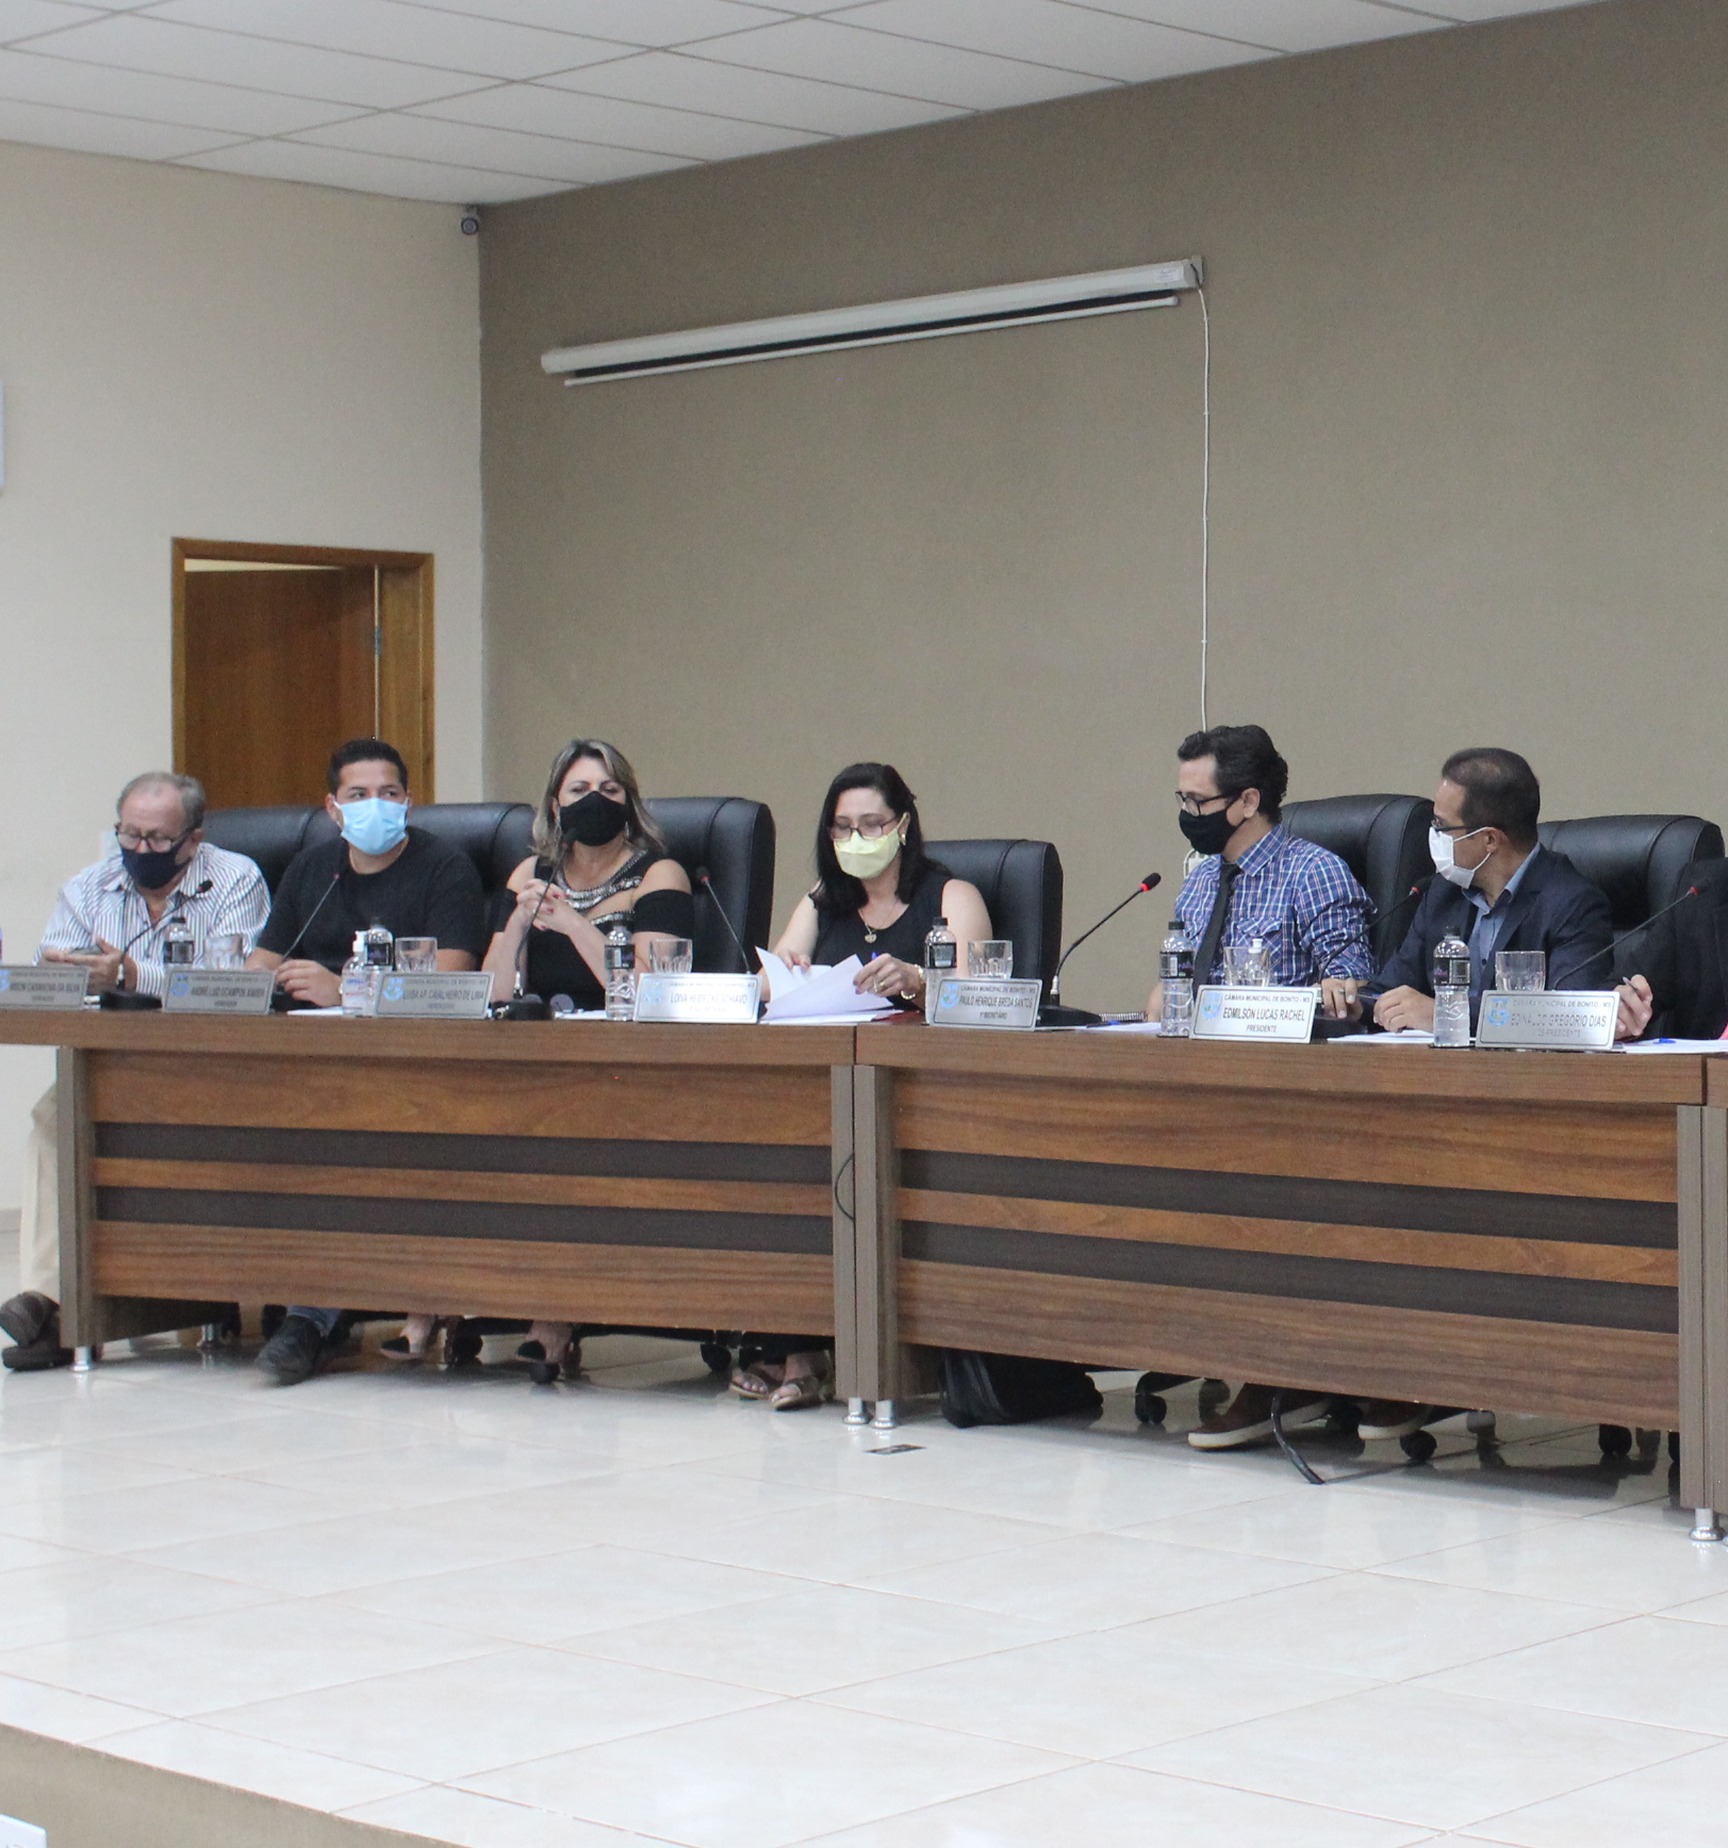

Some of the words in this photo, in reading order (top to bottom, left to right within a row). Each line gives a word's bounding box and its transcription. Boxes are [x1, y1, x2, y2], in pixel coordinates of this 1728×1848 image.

[1577, 1000, 1599, 1008] BONITO
[1223, 1007, 1255, 1020] EDMILSON
[1256, 1008, 1278, 1020] LUCAS
[1280, 1008, 1305, 1022] RACHEL
[1589, 1014, 1607, 1027] DIAS
[1246, 1024, 1278, 1033] PRESIDENTE
